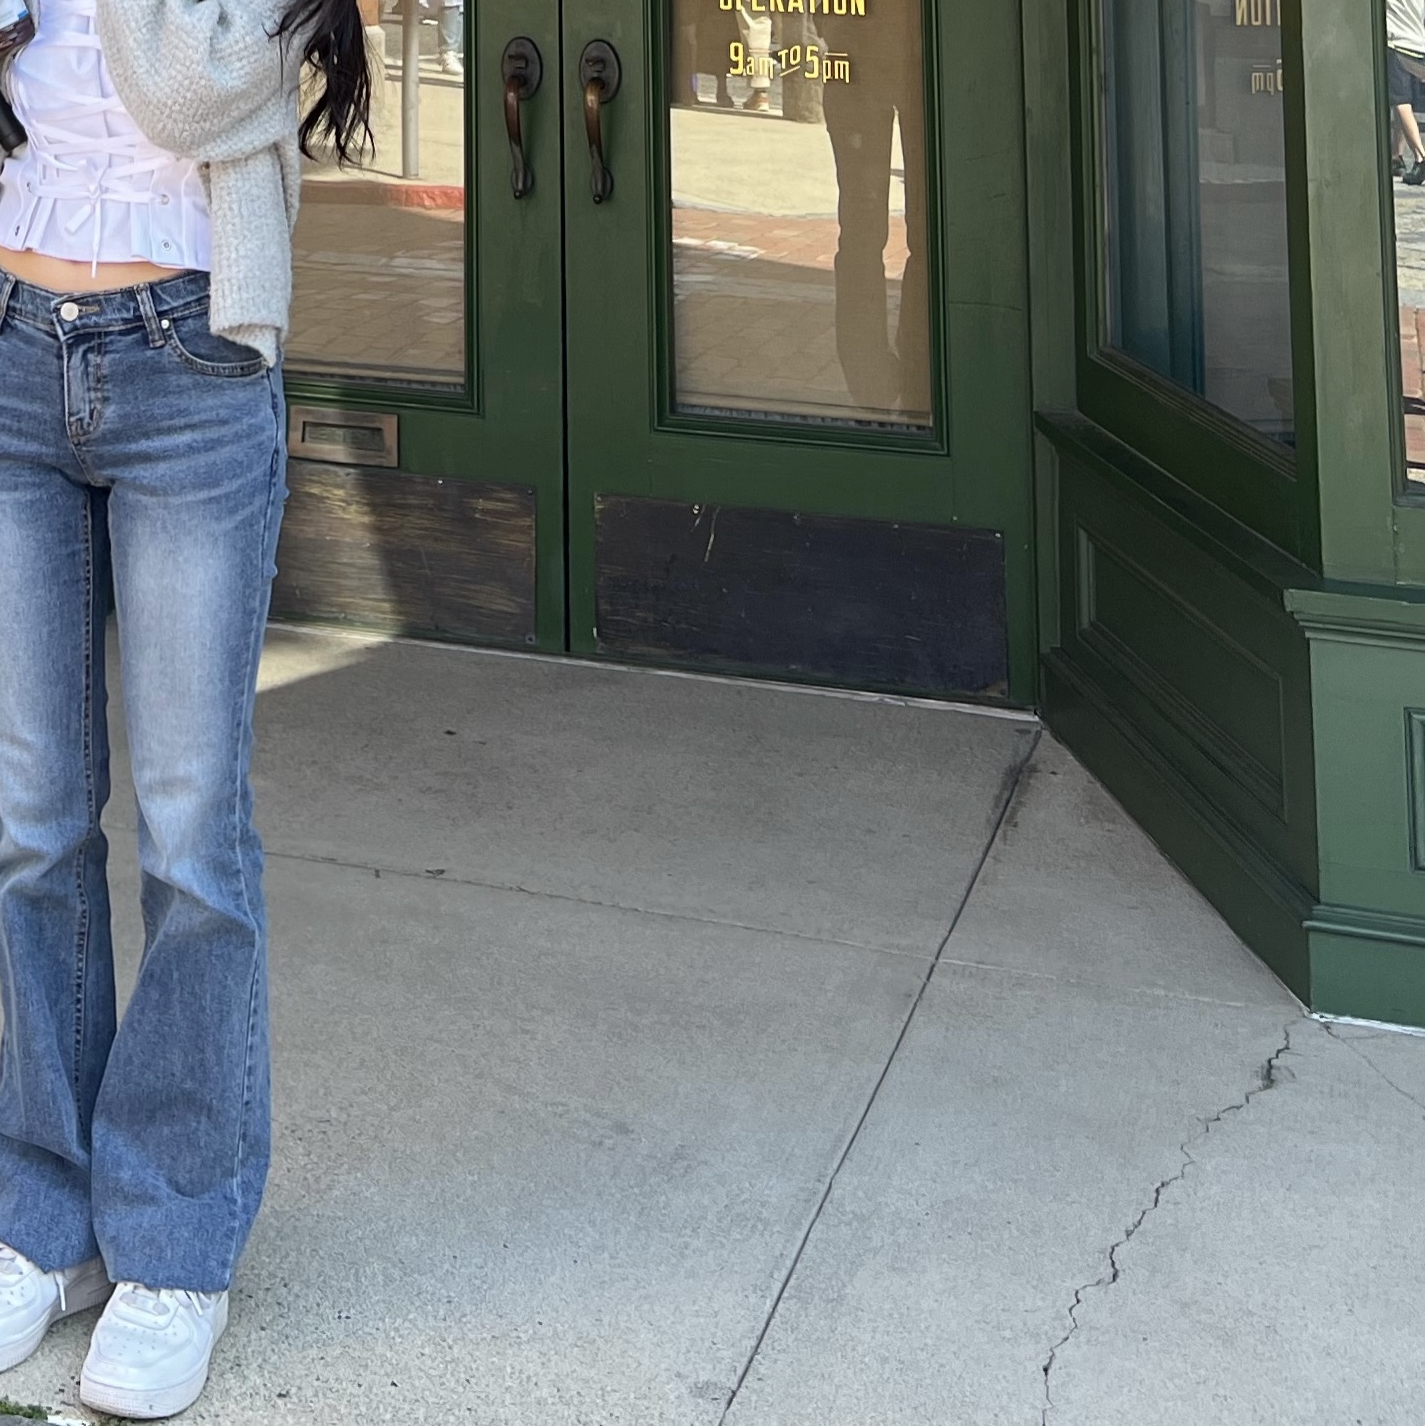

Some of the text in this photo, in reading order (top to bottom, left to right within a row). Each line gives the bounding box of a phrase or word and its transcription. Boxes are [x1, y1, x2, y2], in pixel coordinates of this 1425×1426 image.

[729, 42, 851, 84] 9am TO 5pm
